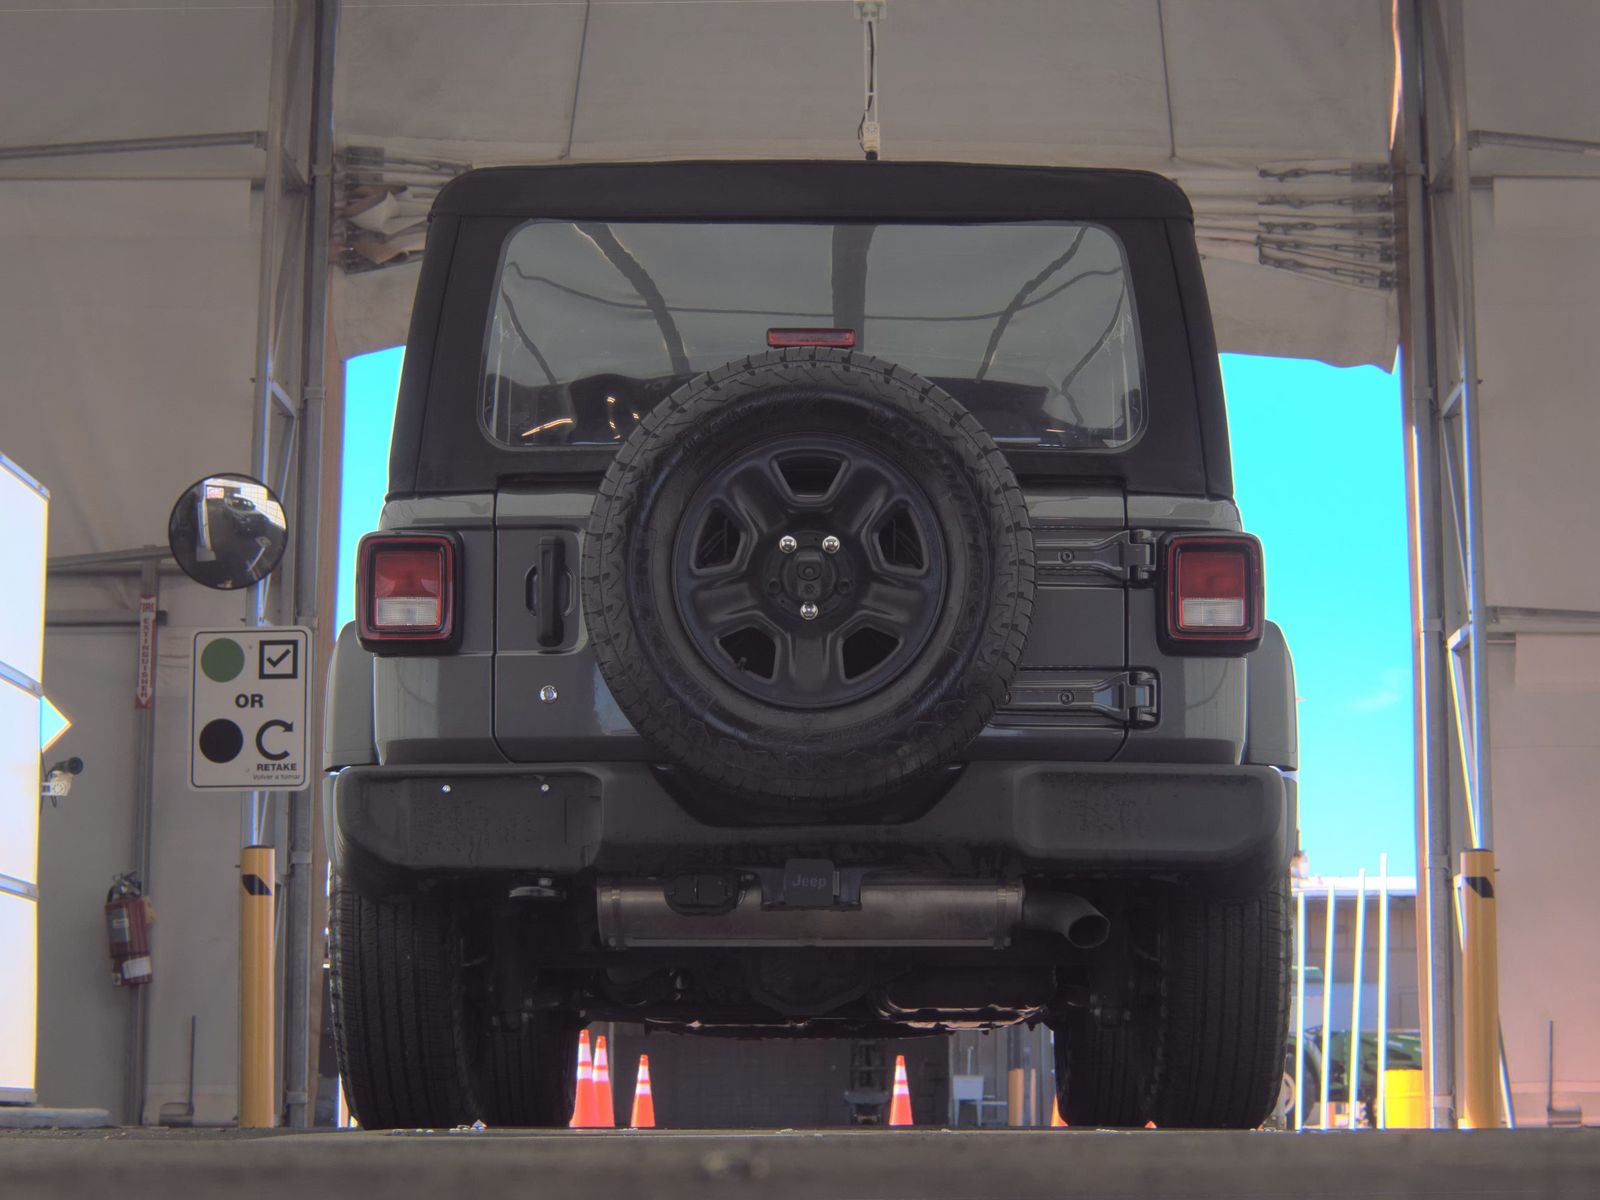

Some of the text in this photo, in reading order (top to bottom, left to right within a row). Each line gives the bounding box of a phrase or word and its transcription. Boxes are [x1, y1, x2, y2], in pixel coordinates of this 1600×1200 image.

[141, 618, 150, 698] EXTINGUISHER
[235, 693, 264, 708] OR
[256, 763, 297, 772] RETAKE
[791, 874, 827, 889] Jeep
